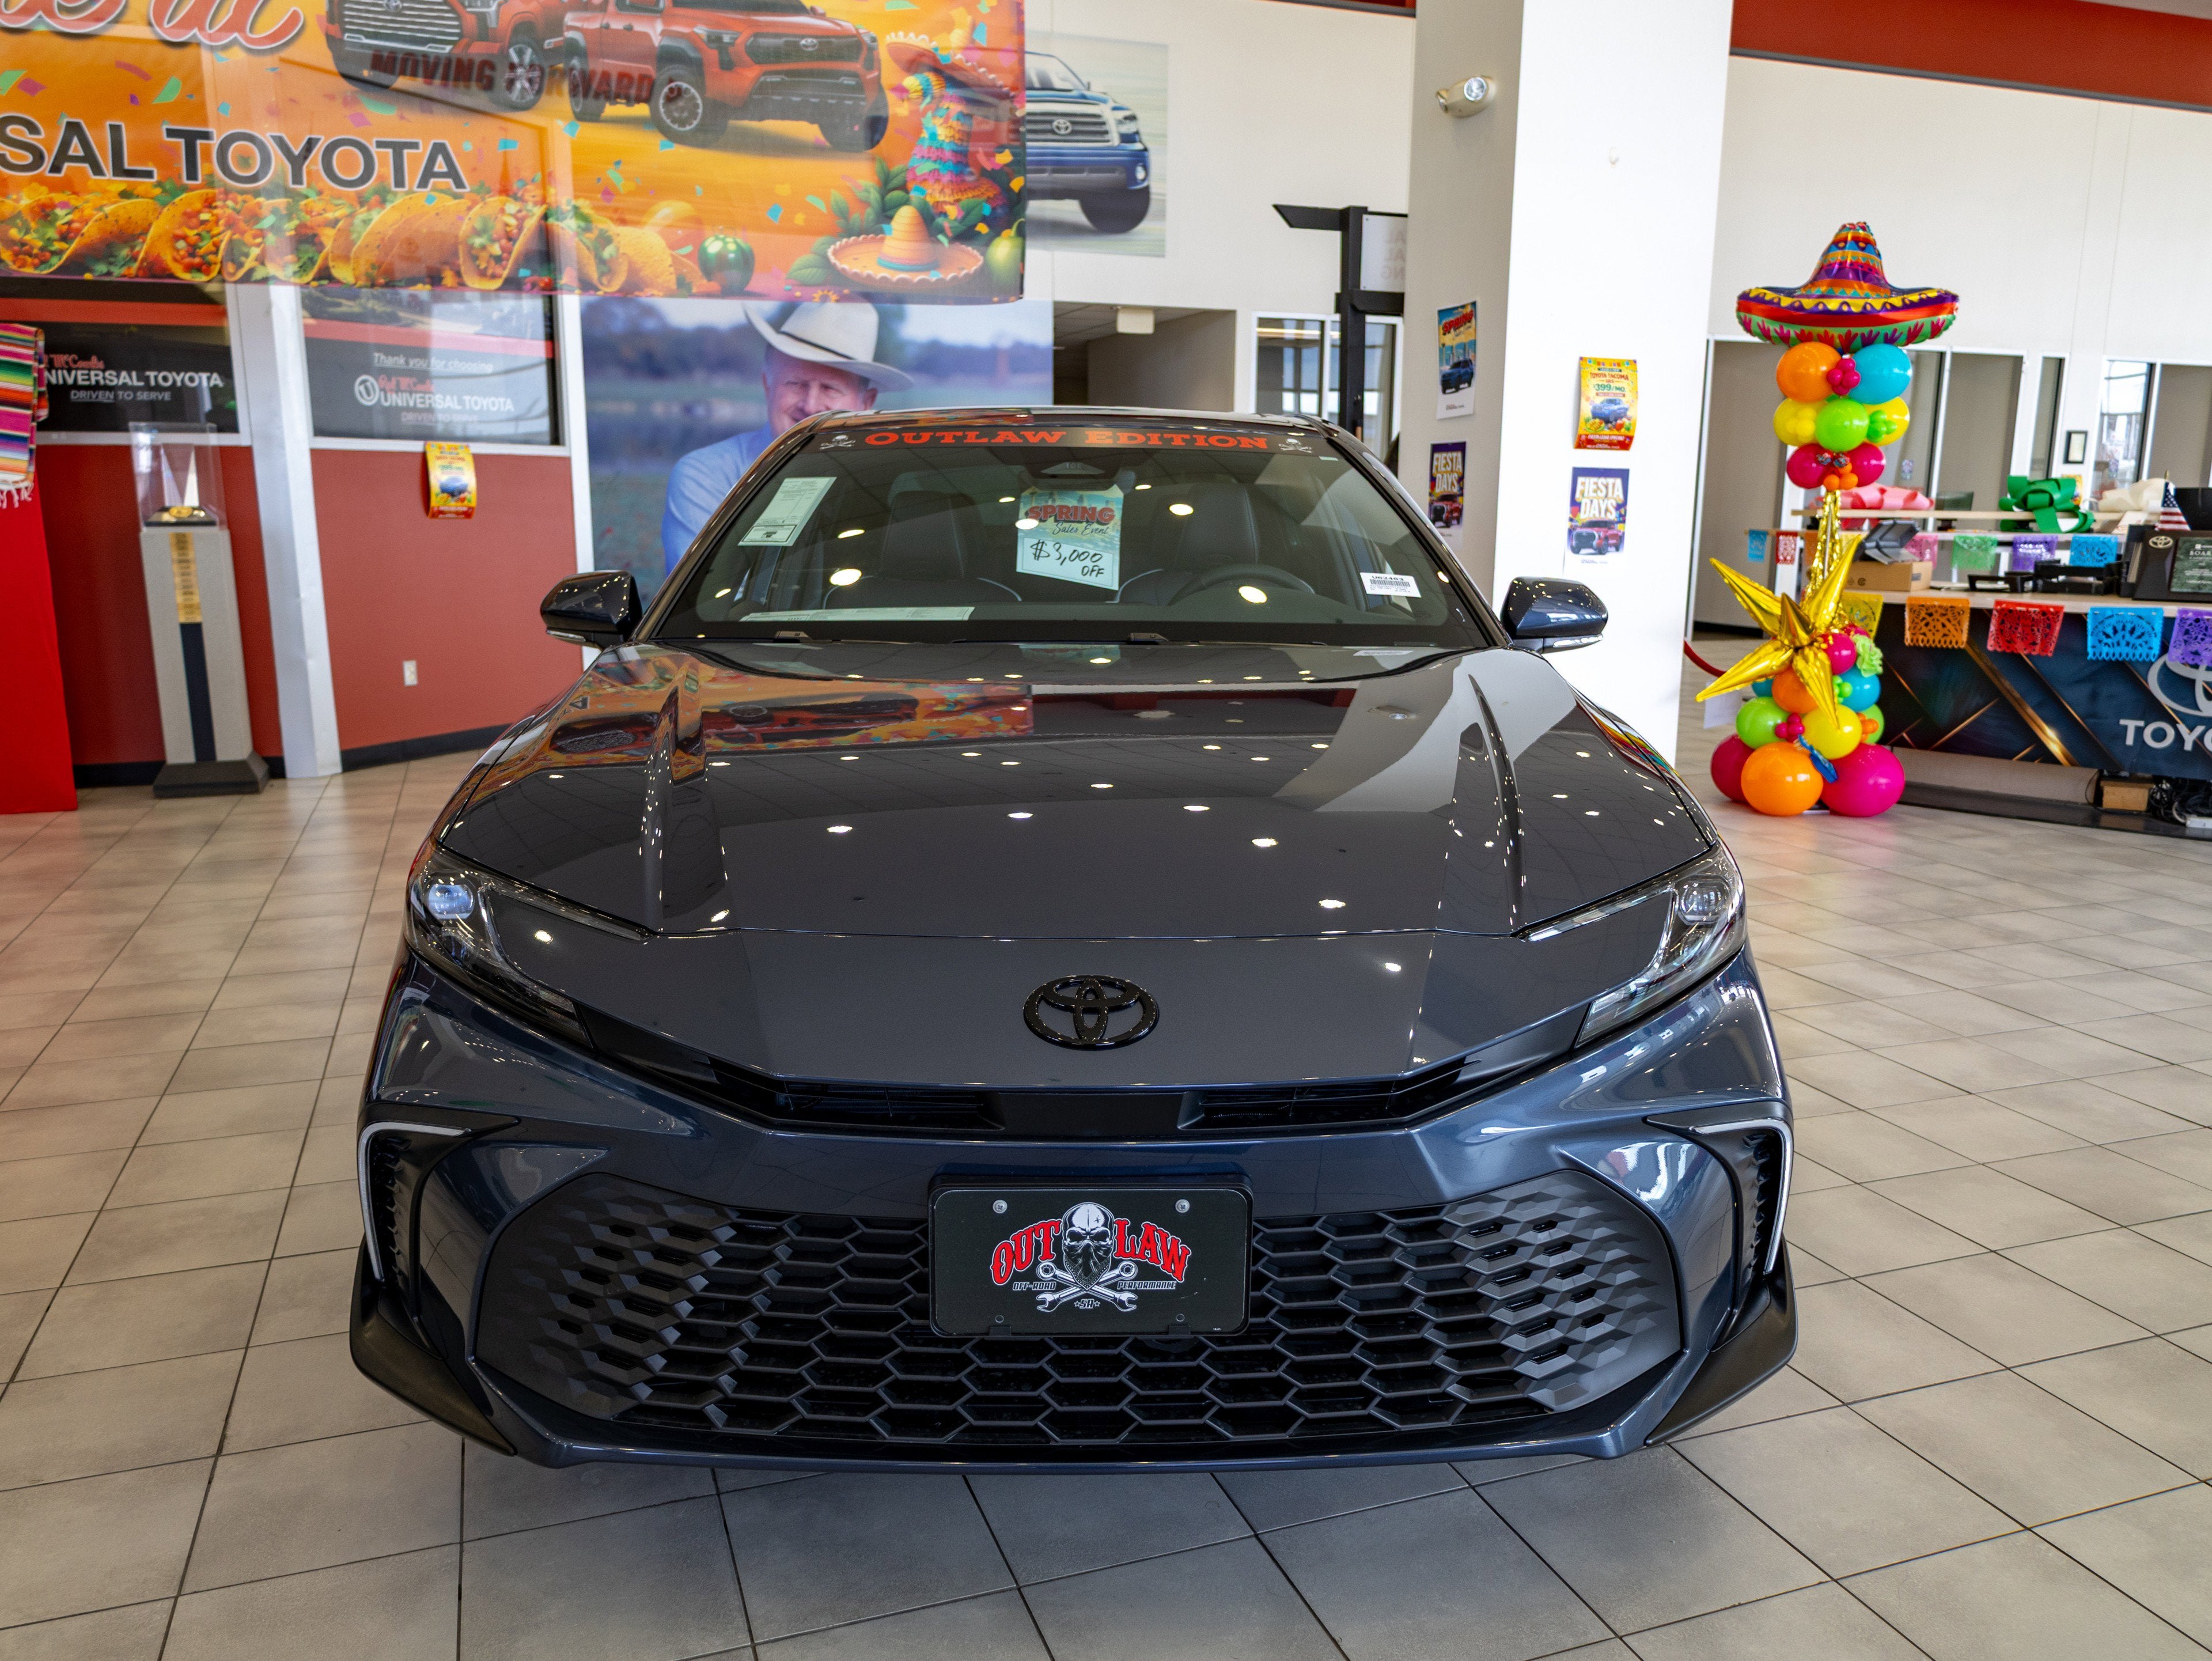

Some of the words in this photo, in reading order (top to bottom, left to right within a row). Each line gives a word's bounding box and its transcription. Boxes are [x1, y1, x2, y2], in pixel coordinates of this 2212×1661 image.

[371, 50, 496, 90] MOVING
[164, 126, 469, 191] TOYOTA
[45, 369, 145, 387] NIVERSAL
[145, 371, 224, 388] TOYOTA
[70, 389, 114, 402] DRIVEN
[118, 391, 133, 400] TO
[137, 391, 171, 401] SERVE
[380, 391, 461, 410] UNIVERSAL
[463, 395, 514, 411] TOYOTA
[865, 431, 1067, 445] OUTLAW
[1084, 431, 1268, 449] EDITION
[1433, 452, 1463, 475] FIESTA
[1435, 473, 1458, 494] DAYS
[1575, 476, 1624, 502] FIESTA
[1025, 505, 1115, 524] SPRING
[1580, 498, 1617, 520] DAYS
[1052, 522, 1078, 535] Sales
[1081, 522, 1109, 535] Event
[1030, 540, 1103, 566] $3,000
[1081, 565, 1104, 577] OFF
[2119, 719, 2212, 752] TOY
[1013, 1281, 1056, 1291] OFF-ROAD
[1117, 1281, 1176, 1289] PERFORMANCE
